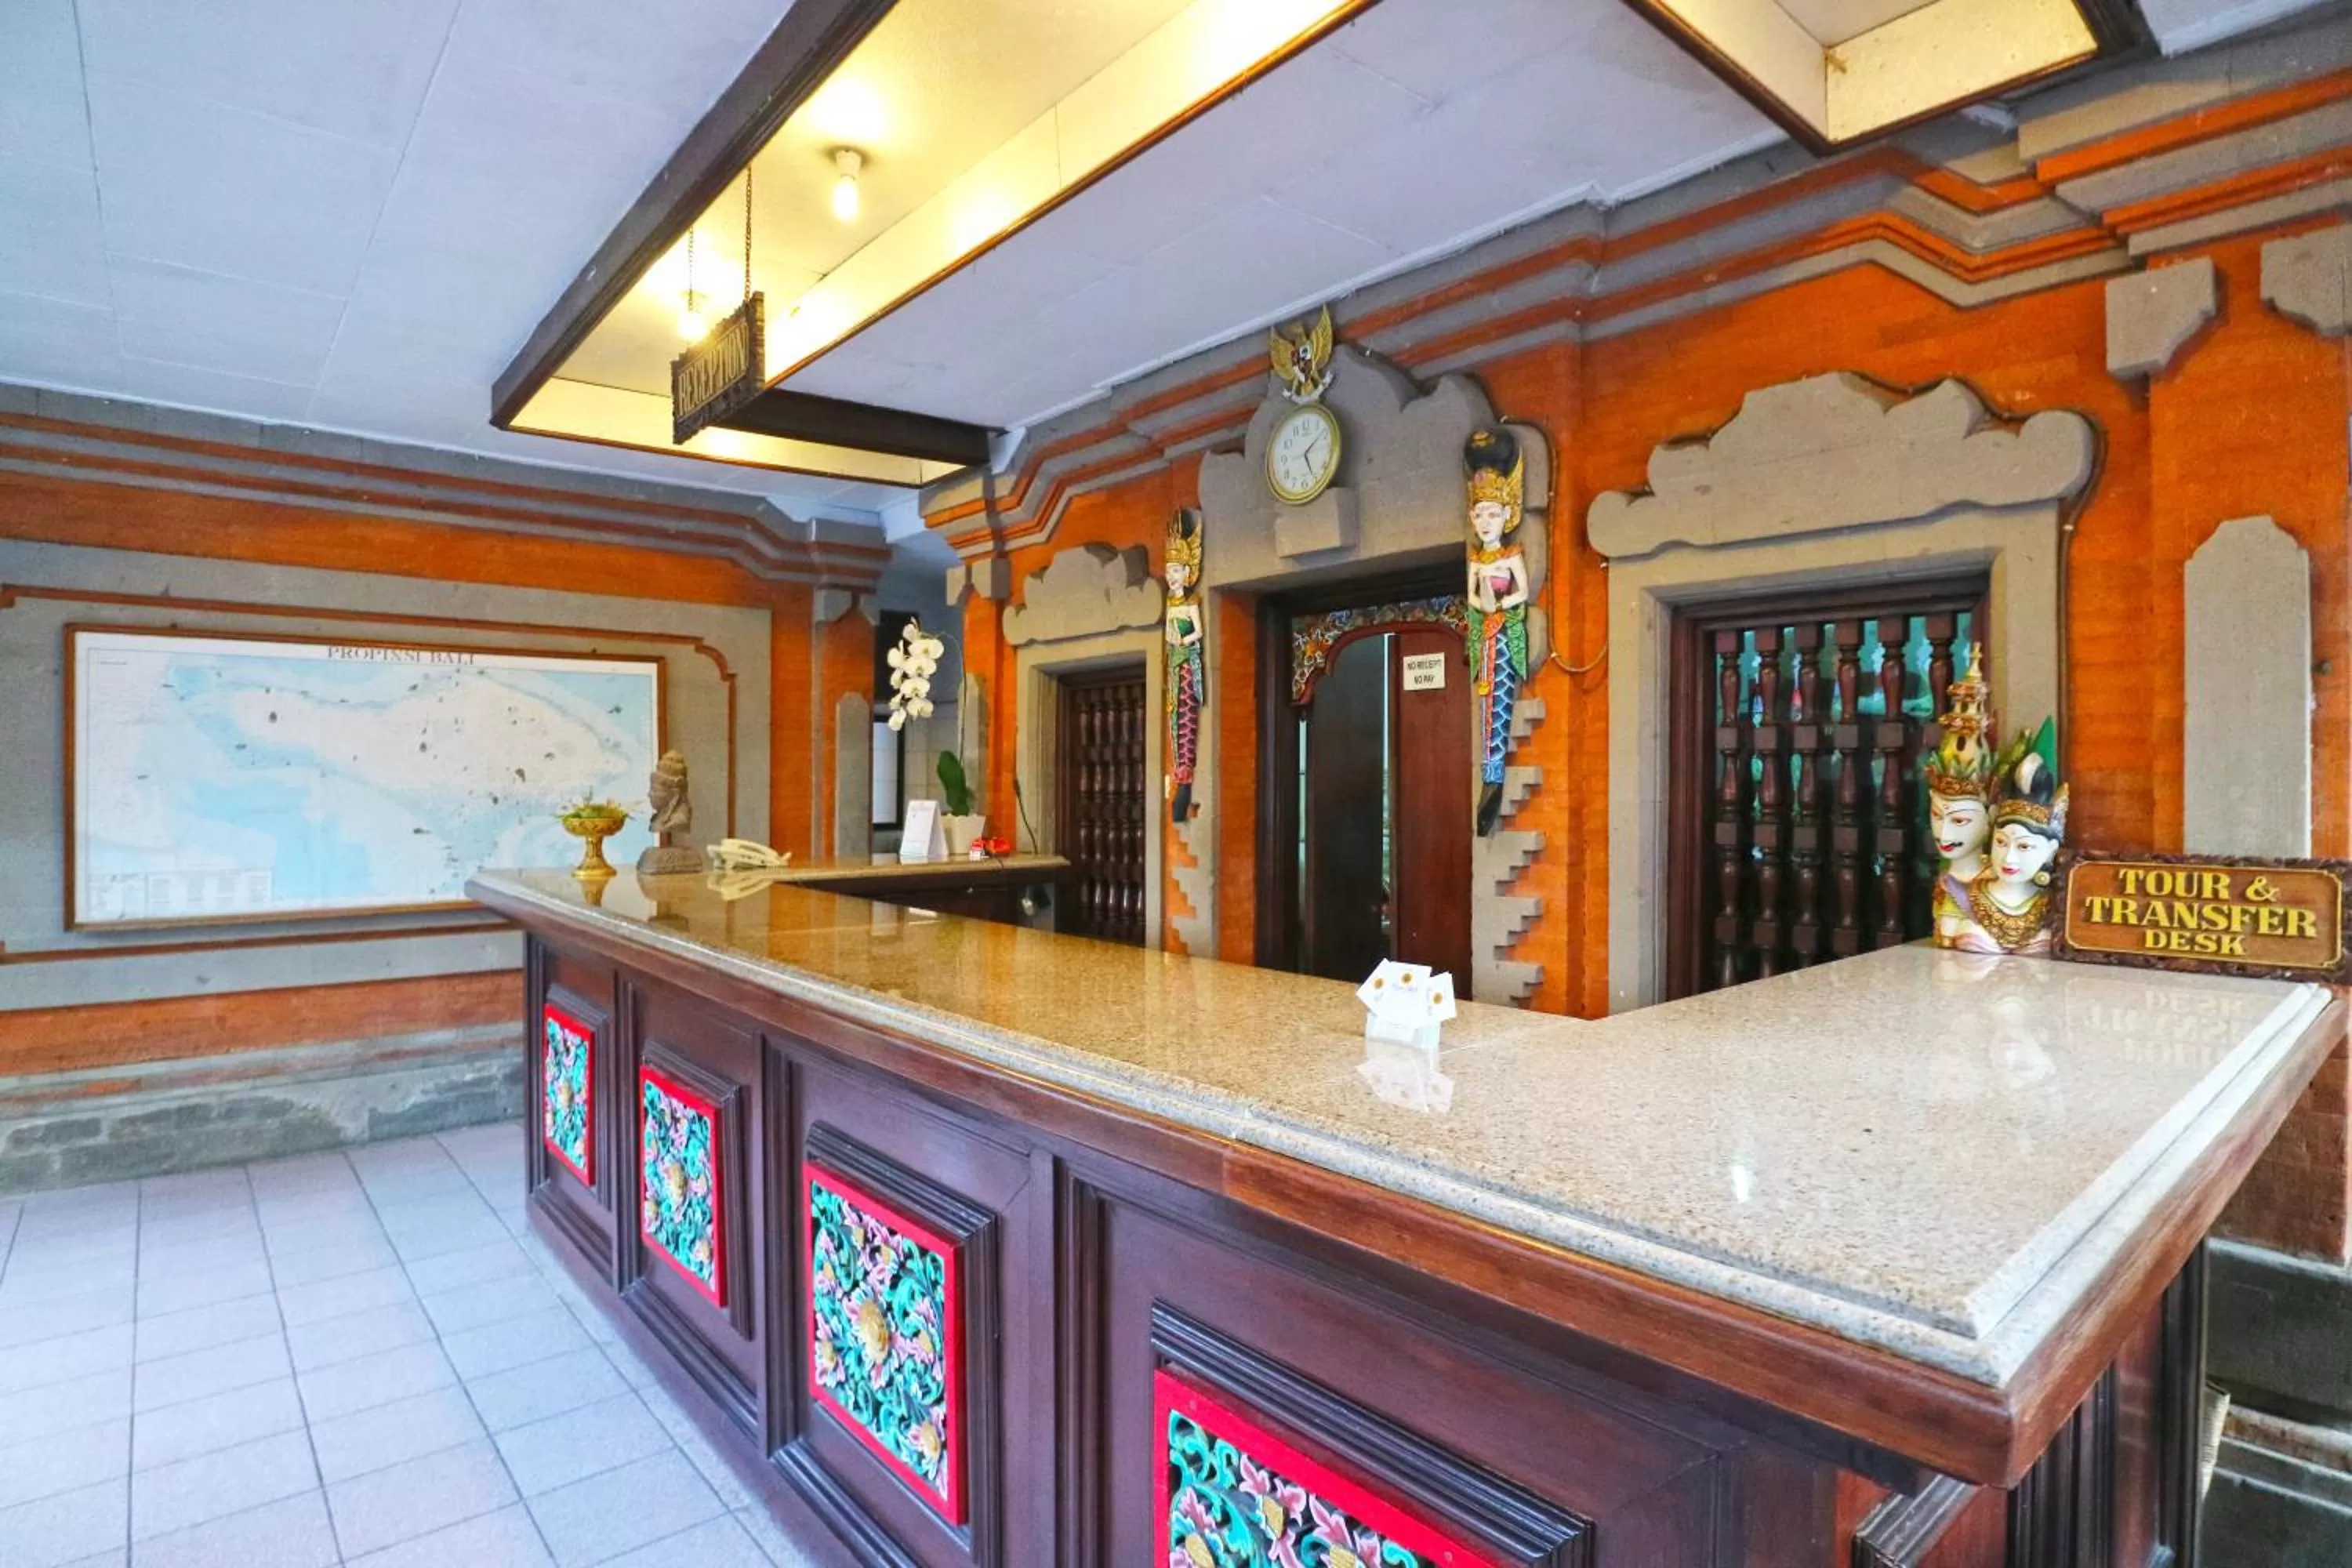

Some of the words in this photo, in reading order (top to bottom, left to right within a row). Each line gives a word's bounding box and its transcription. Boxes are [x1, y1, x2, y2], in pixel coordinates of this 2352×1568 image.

[677, 324, 749, 417] RECEPTION
[328, 646, 420, 664] PROPINSI
[430, 652, 474, 665] BALI
[1407, 661, 1417, 670] NO
[2118, 868, 2230, 900] TOUR
[2245, 876, 2280, 902] &
[2085, 896, 2318, 938] TRANSFER
[2144, 928, 2246, 956] DESK
